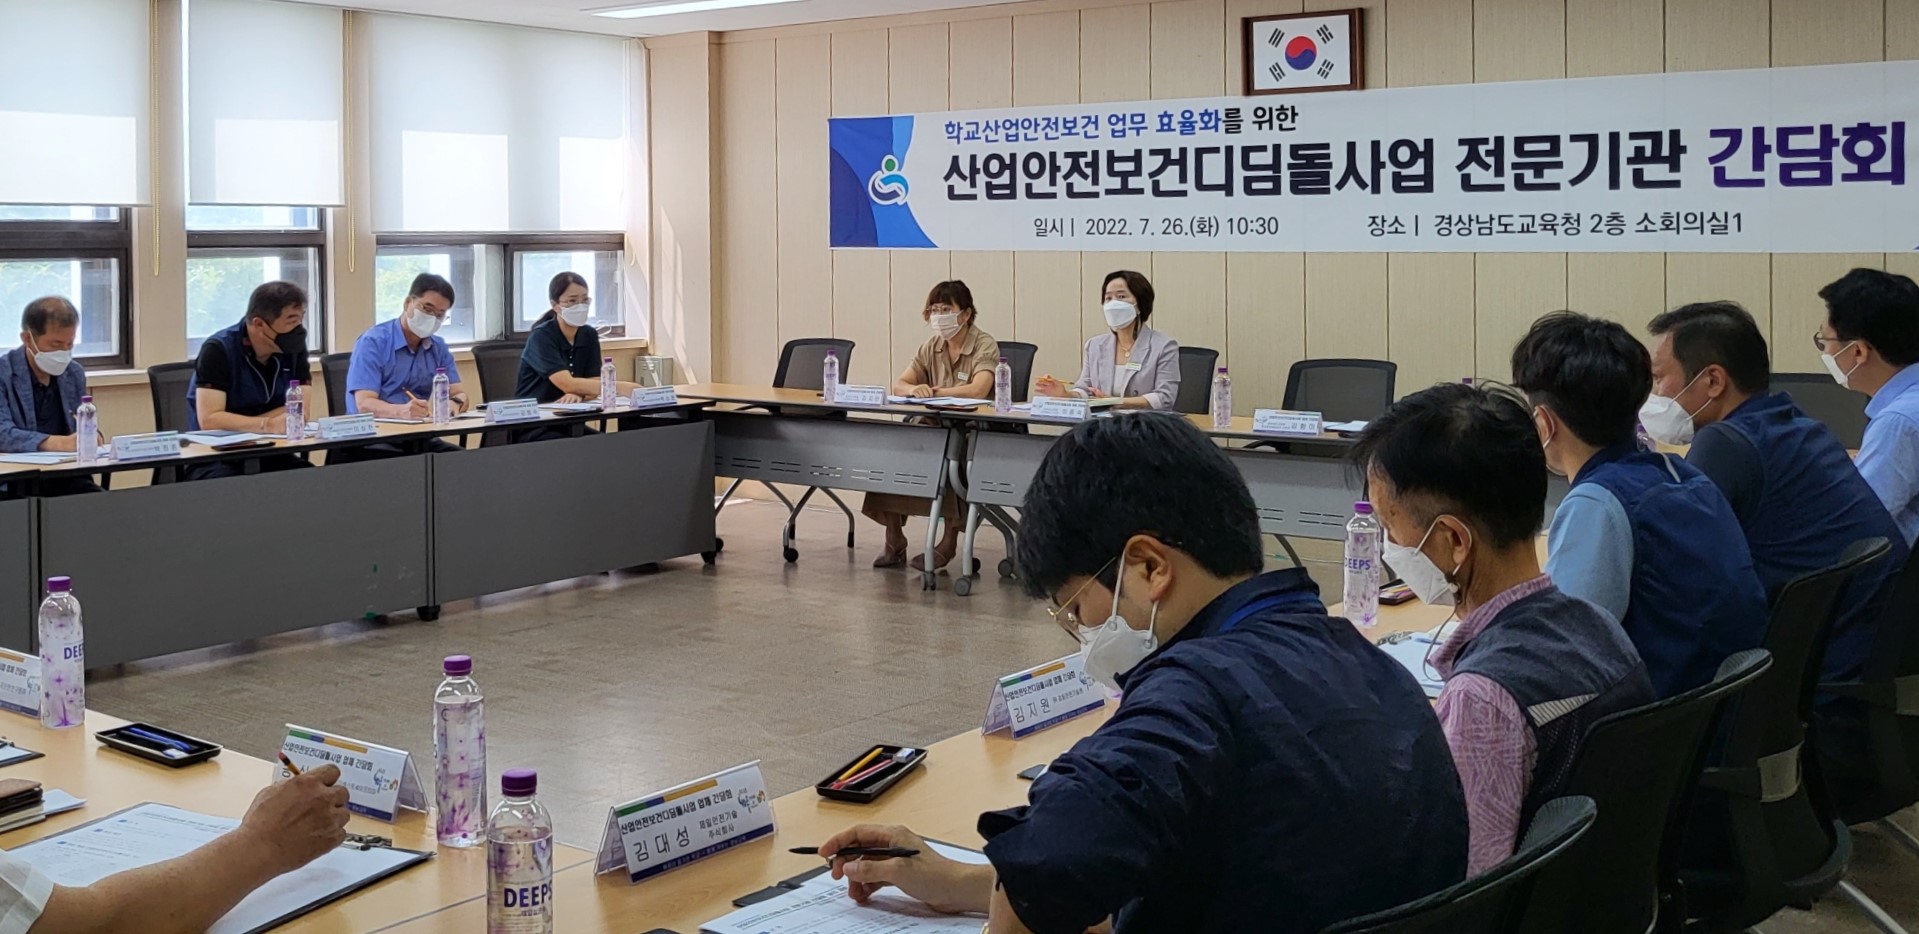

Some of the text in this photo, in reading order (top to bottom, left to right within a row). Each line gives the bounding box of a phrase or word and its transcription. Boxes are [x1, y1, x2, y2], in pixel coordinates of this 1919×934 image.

[945, 105, 1299, 144] 학교산업안전보건 업무 효율화를 위한
[943, 121, 1906, 201] 산업안전보건디딤돌사업 전문기관 간담회
[1034, 215, 1279, 238] 일시 2022. 7. 26.(화) 10:30
[1368, 211, 1742, 237] 장소 경상남도교육청 2층 소회의실1
[712, 788, 734, 804] 간담회
